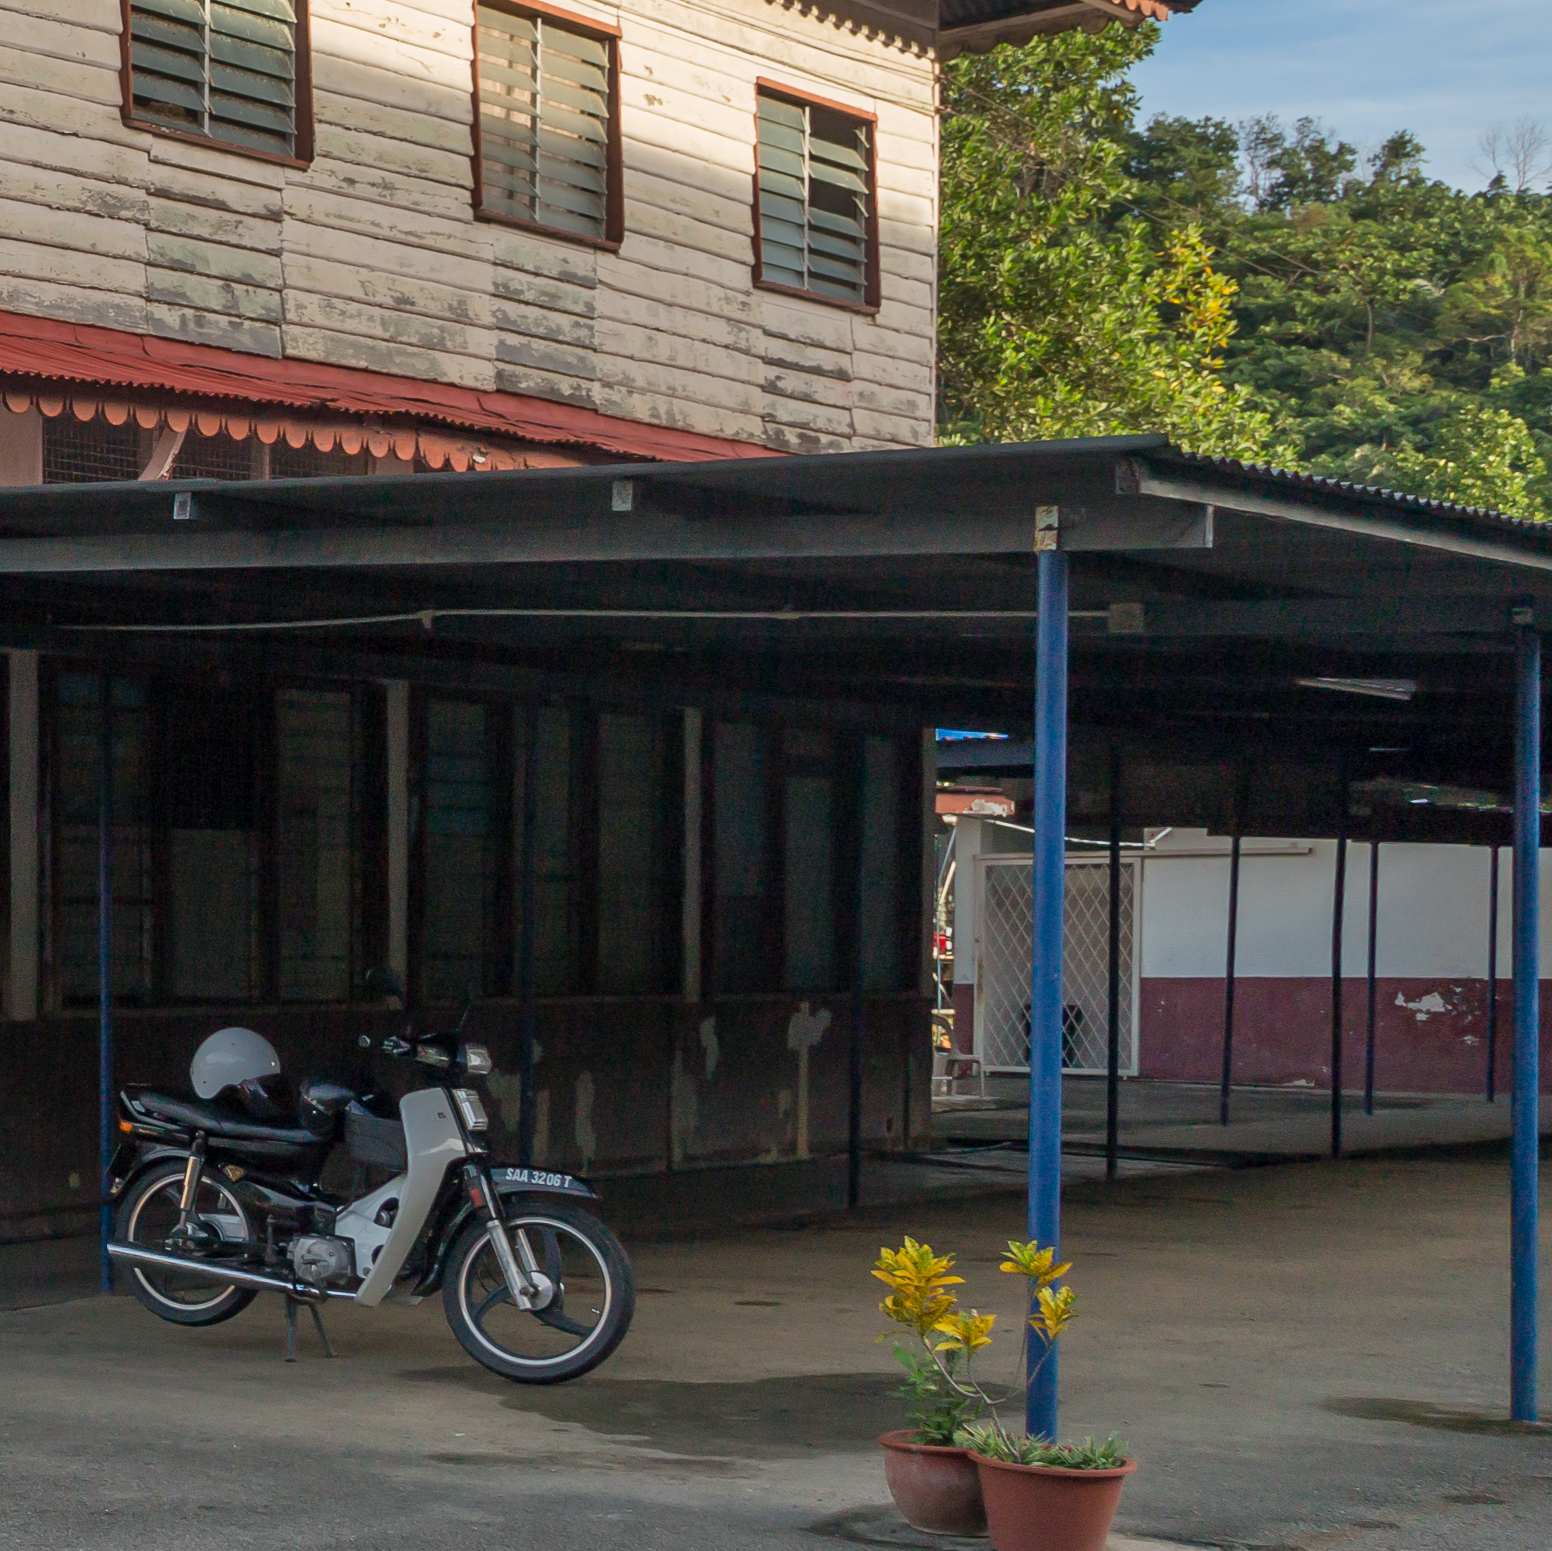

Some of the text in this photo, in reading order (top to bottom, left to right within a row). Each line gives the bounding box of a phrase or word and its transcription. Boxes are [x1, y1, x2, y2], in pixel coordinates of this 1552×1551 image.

[505, 1167, 573, 1188] SAA 3206 T
